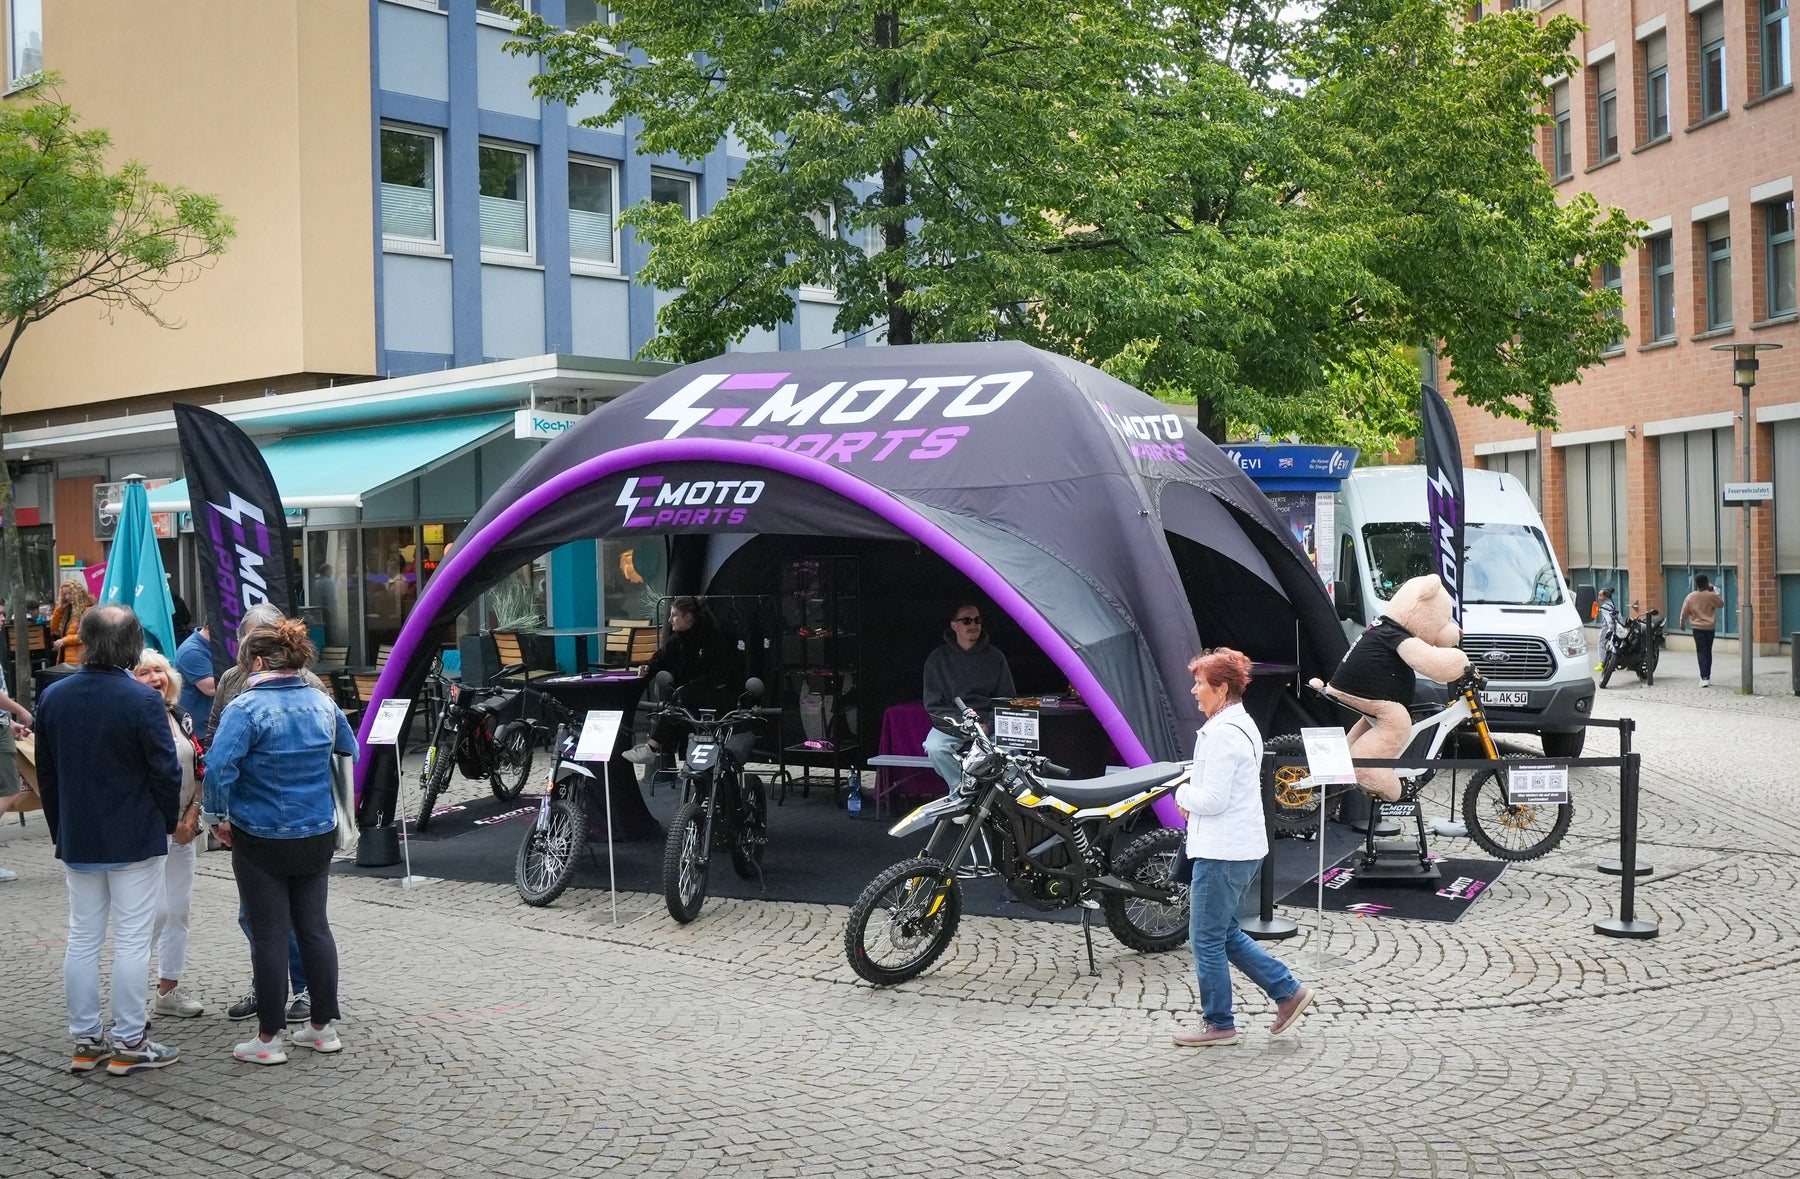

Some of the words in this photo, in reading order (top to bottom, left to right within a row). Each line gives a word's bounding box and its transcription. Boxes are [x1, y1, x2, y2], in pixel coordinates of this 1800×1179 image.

[1241, 459, 1261, 469] EVI
[1337, 459, 1350, 470] EVI
[654, 480, 765, 506] MOTO
[654, 508, 748, 526] PARTS
[1438, 515, 1461, 626] MOT
[1514, 692, 1527, 703] 50
